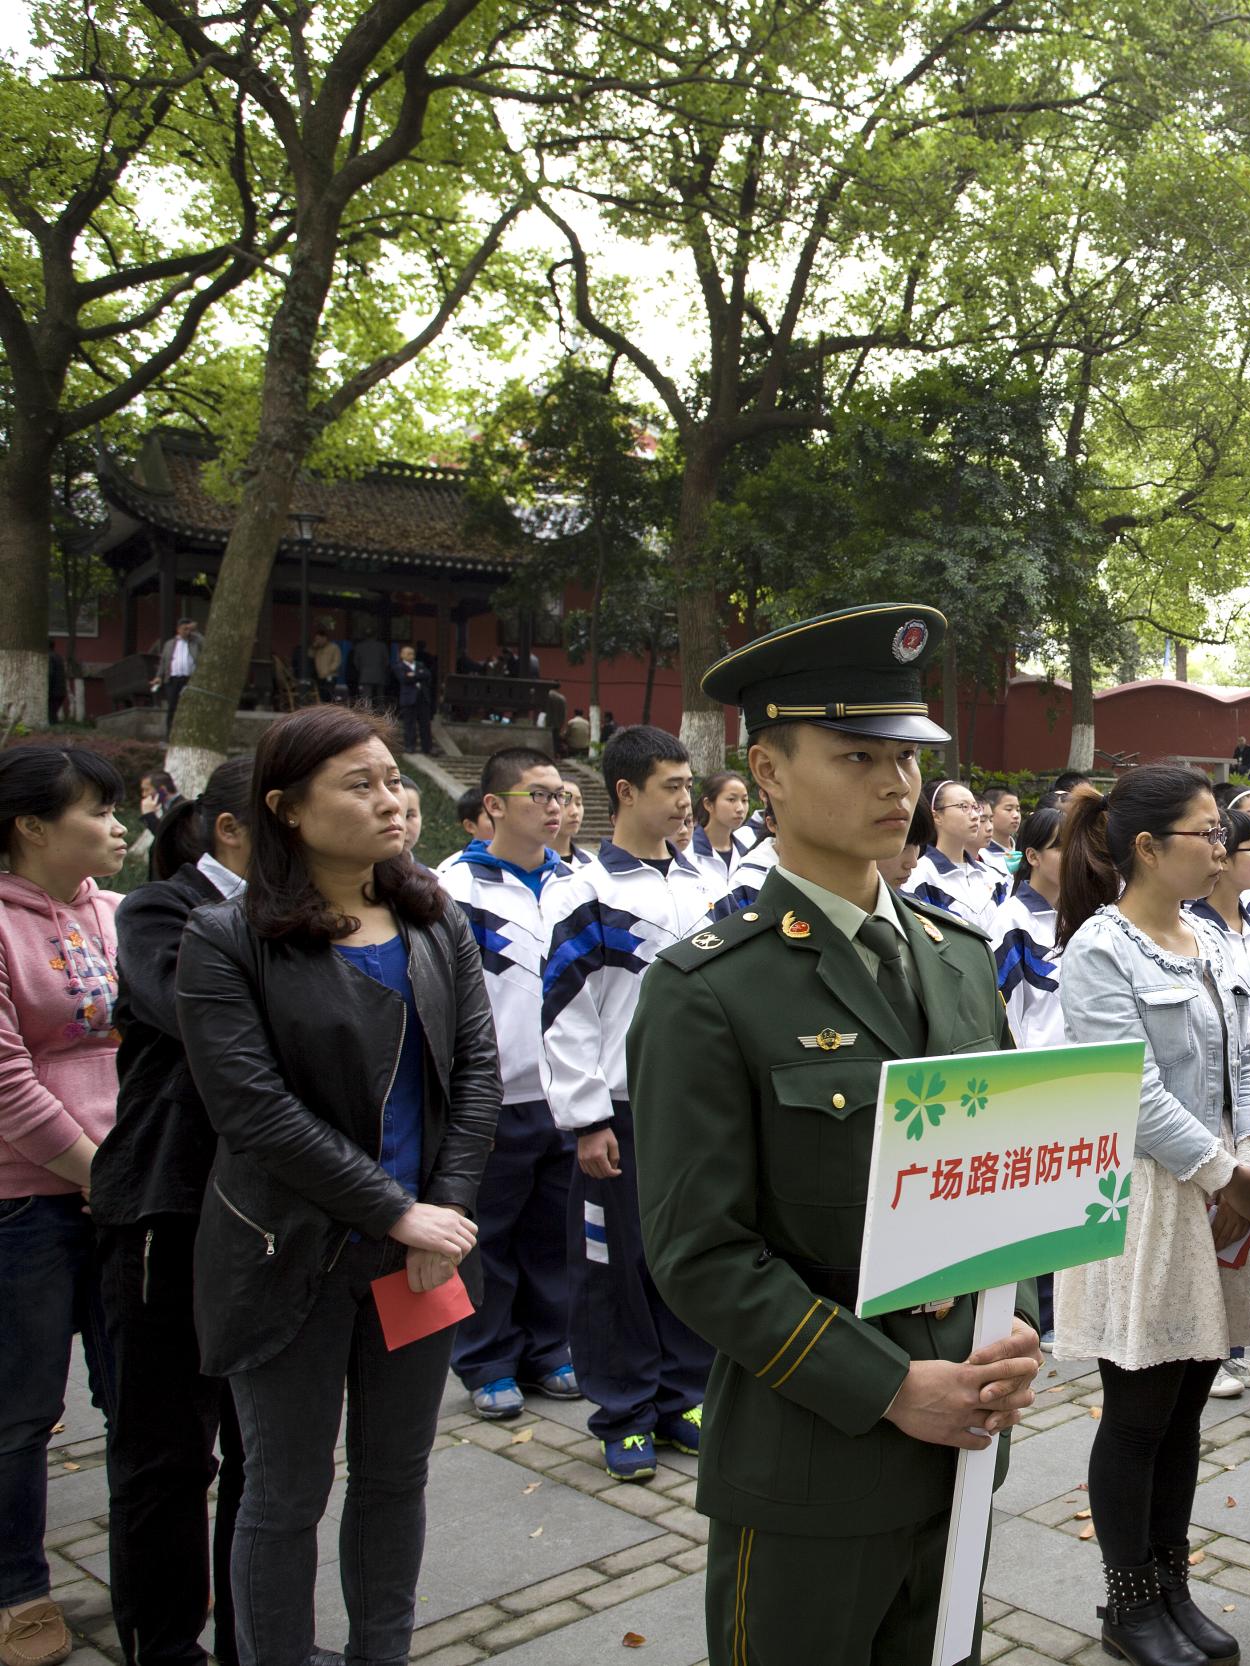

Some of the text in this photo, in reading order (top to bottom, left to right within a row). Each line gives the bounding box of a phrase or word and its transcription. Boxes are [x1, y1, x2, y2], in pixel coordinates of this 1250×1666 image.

[890, 1132, 1121, 1210] 广场路消防中队
